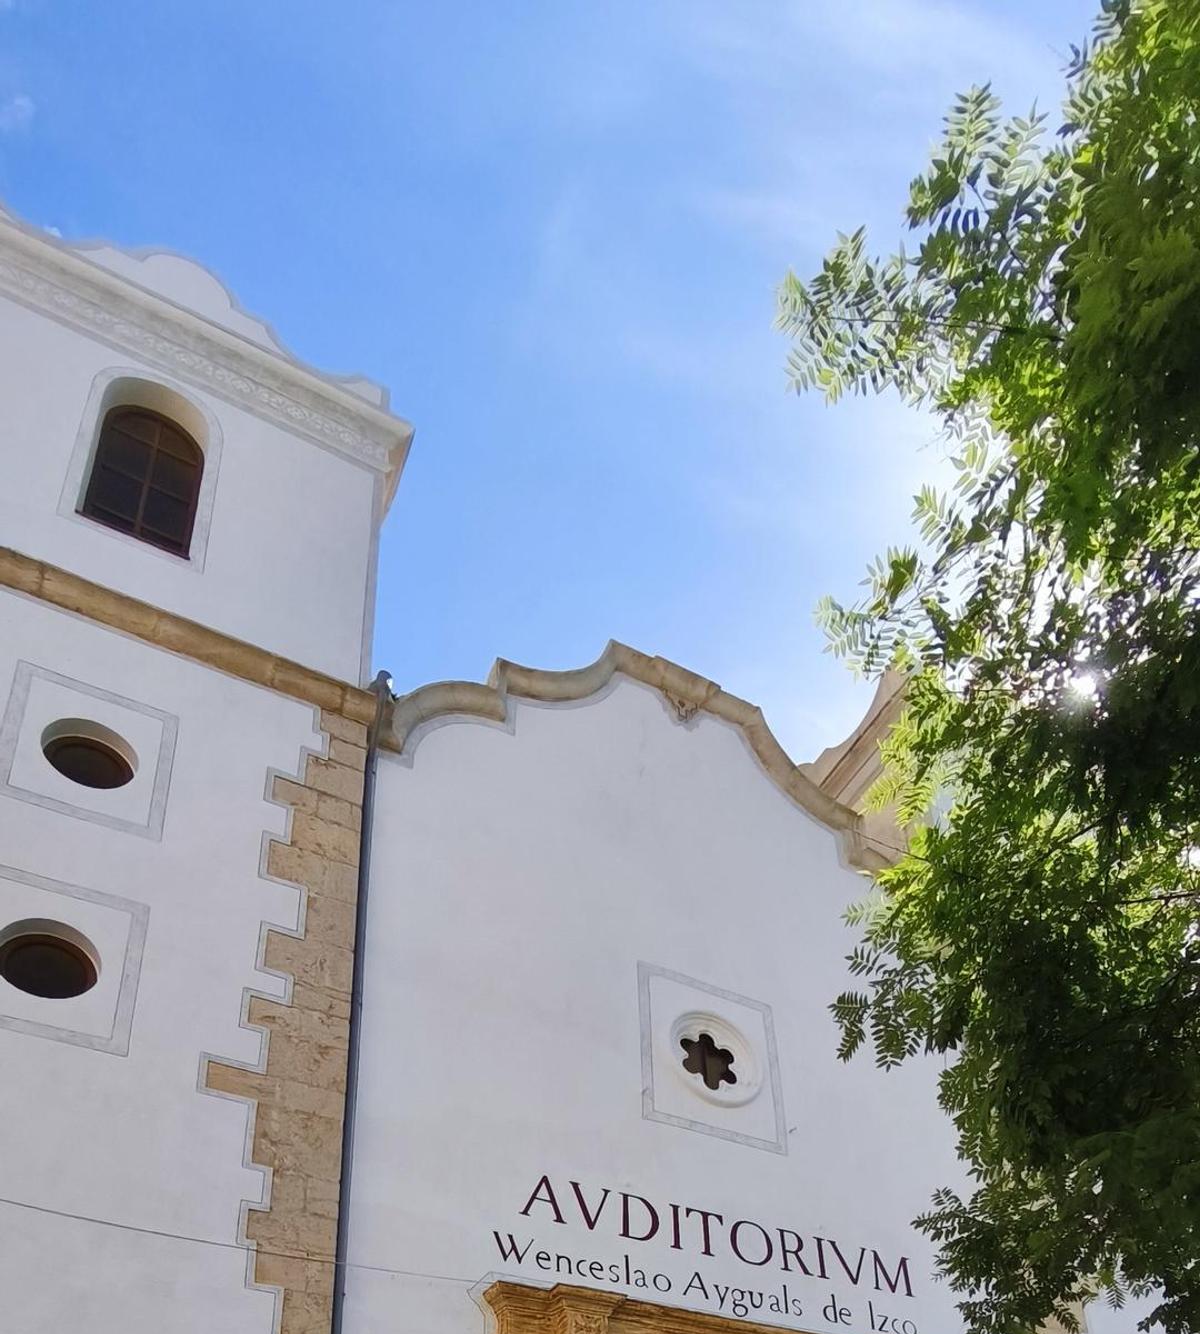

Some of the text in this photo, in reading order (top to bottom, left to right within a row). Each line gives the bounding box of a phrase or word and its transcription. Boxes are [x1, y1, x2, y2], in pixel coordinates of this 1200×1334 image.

[492, 1231, 672, 1293] Wenceslao
[683, 1272, 803, 1318] Ayguals
[823, 1294, 852, 1326] de
[519, 1175, 916, 1298] AVDITORIVM
